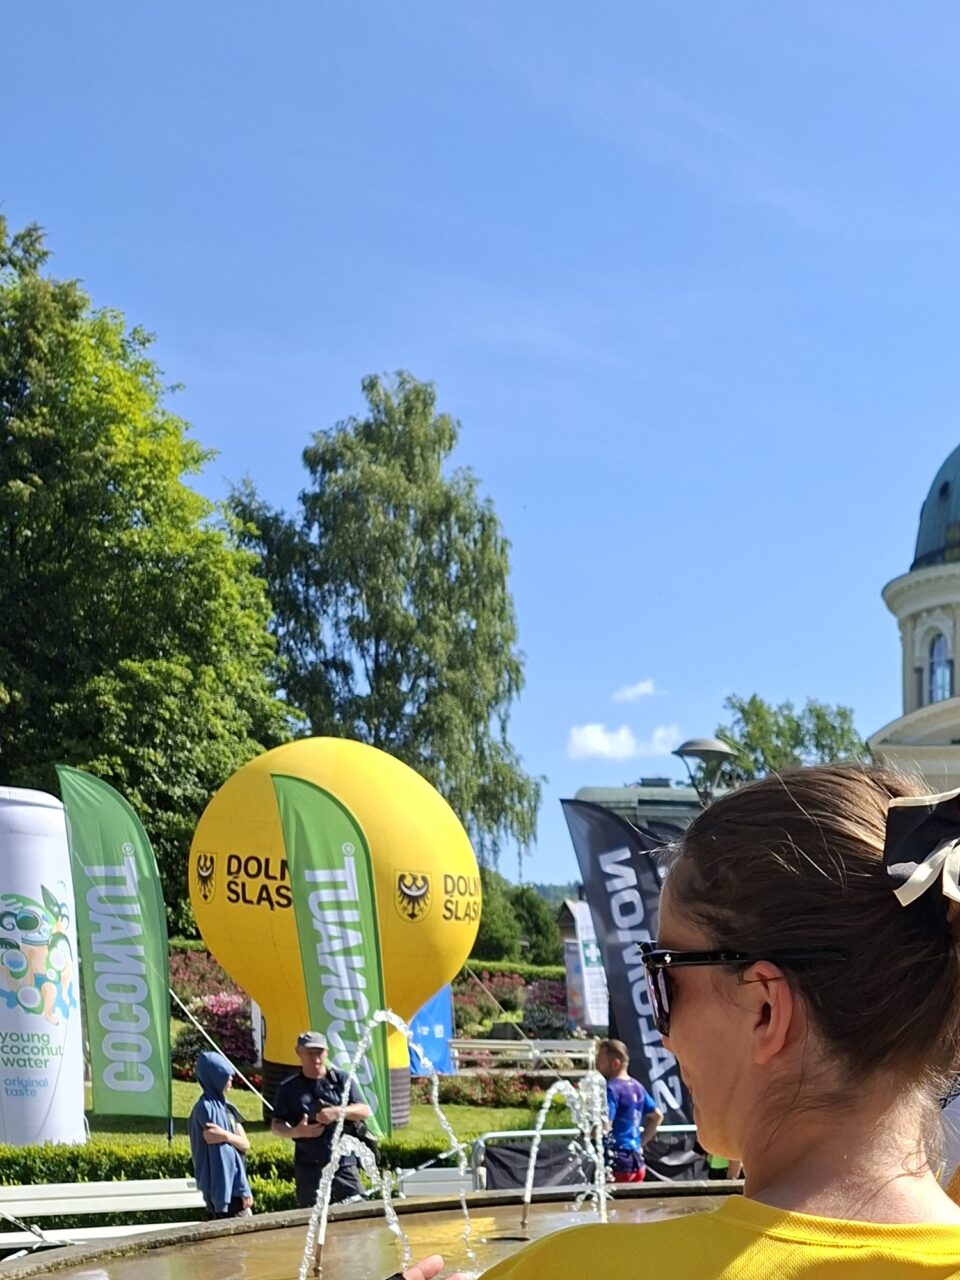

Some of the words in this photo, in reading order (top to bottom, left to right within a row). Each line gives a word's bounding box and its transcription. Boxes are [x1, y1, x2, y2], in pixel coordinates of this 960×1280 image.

[226, 854, 290, 882] DOLN
[443, 874, 480, 897] DOLN
[226, 875, 293, 912] ŚLĄS
[442, 894, 480, 925] ŚLĄS
[0, 1032, 50, 1046] young
[0, 1044, 64, 1057] coconut
[1, 1056, 50, 1068] water
[4, 1076, 49, 1089] original
[5, 1087, 38, 1097] taste
